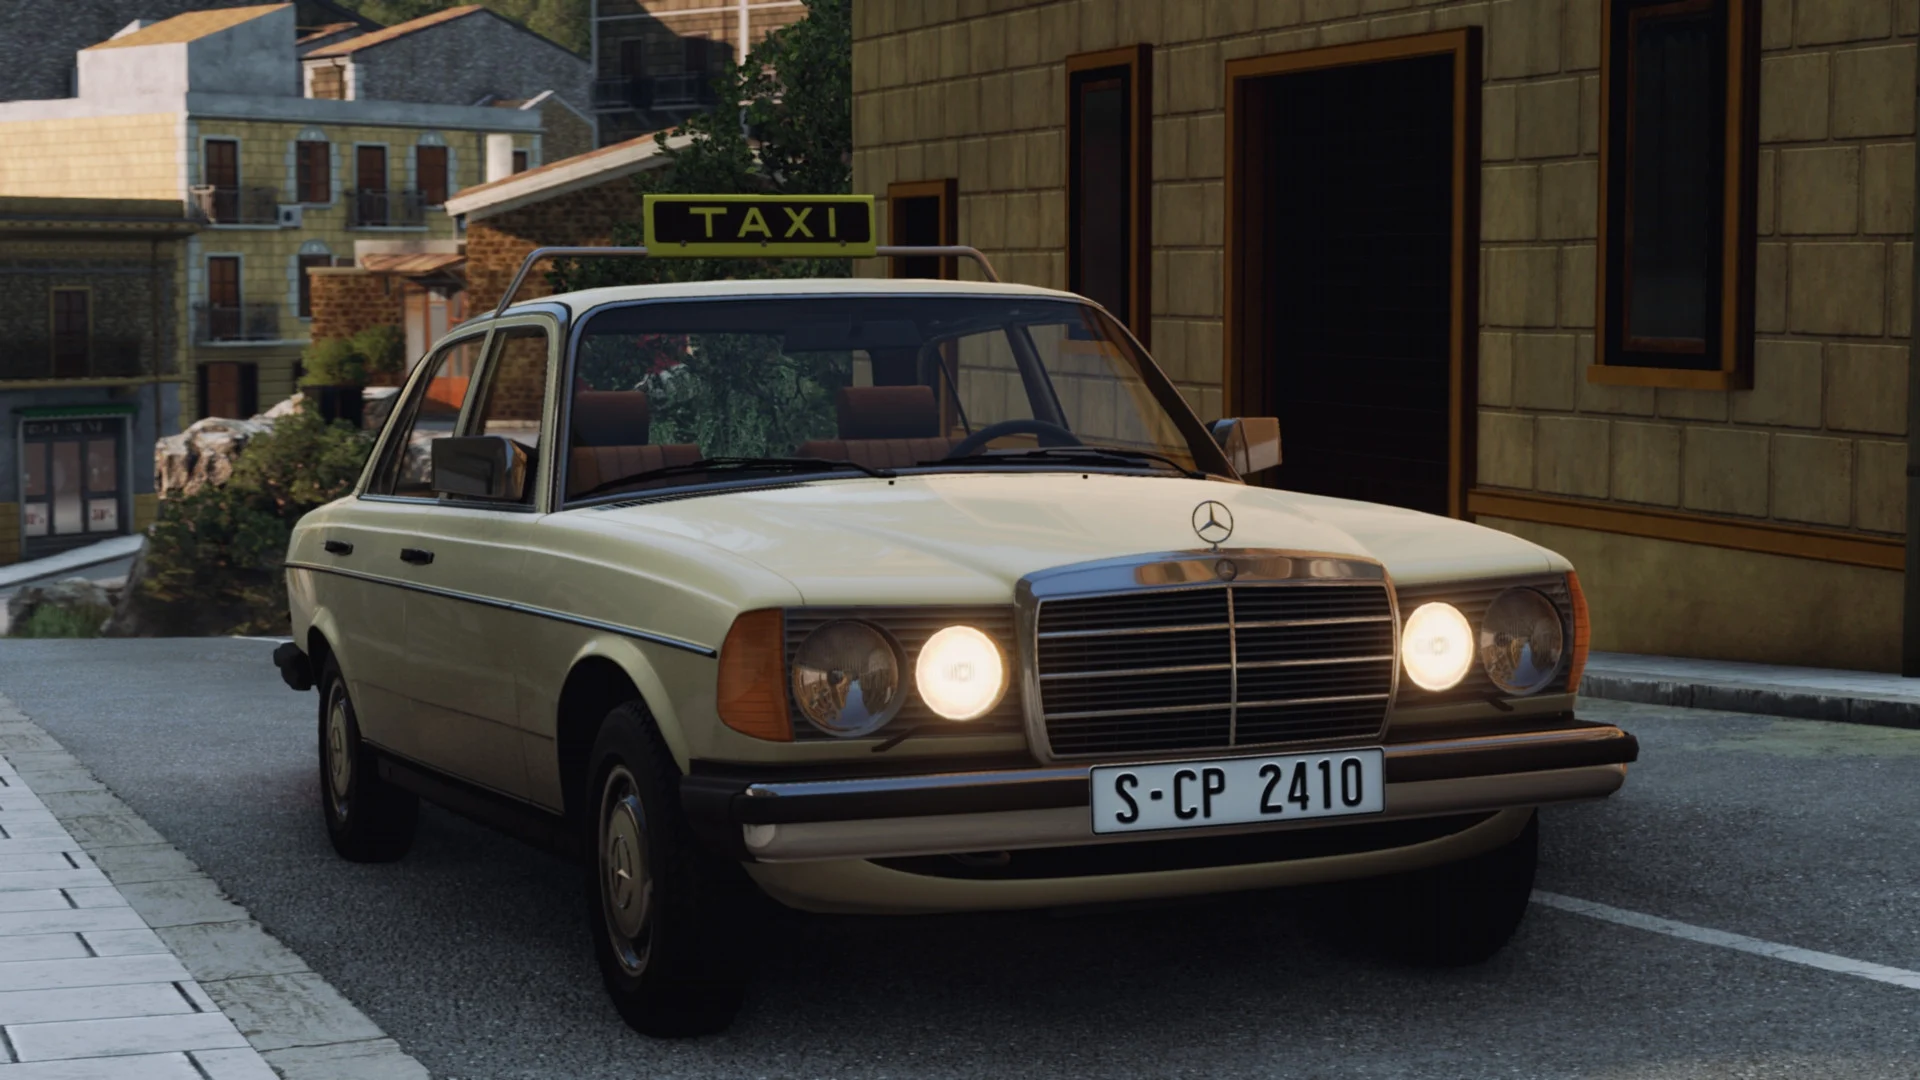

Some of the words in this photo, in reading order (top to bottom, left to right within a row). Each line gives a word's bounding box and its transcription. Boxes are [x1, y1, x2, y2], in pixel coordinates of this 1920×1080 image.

[689, 207, 837, 238] TAXI
[1114, 766, 1226, 824] S-CP
[1259, 756, 1363, 814] 2410
